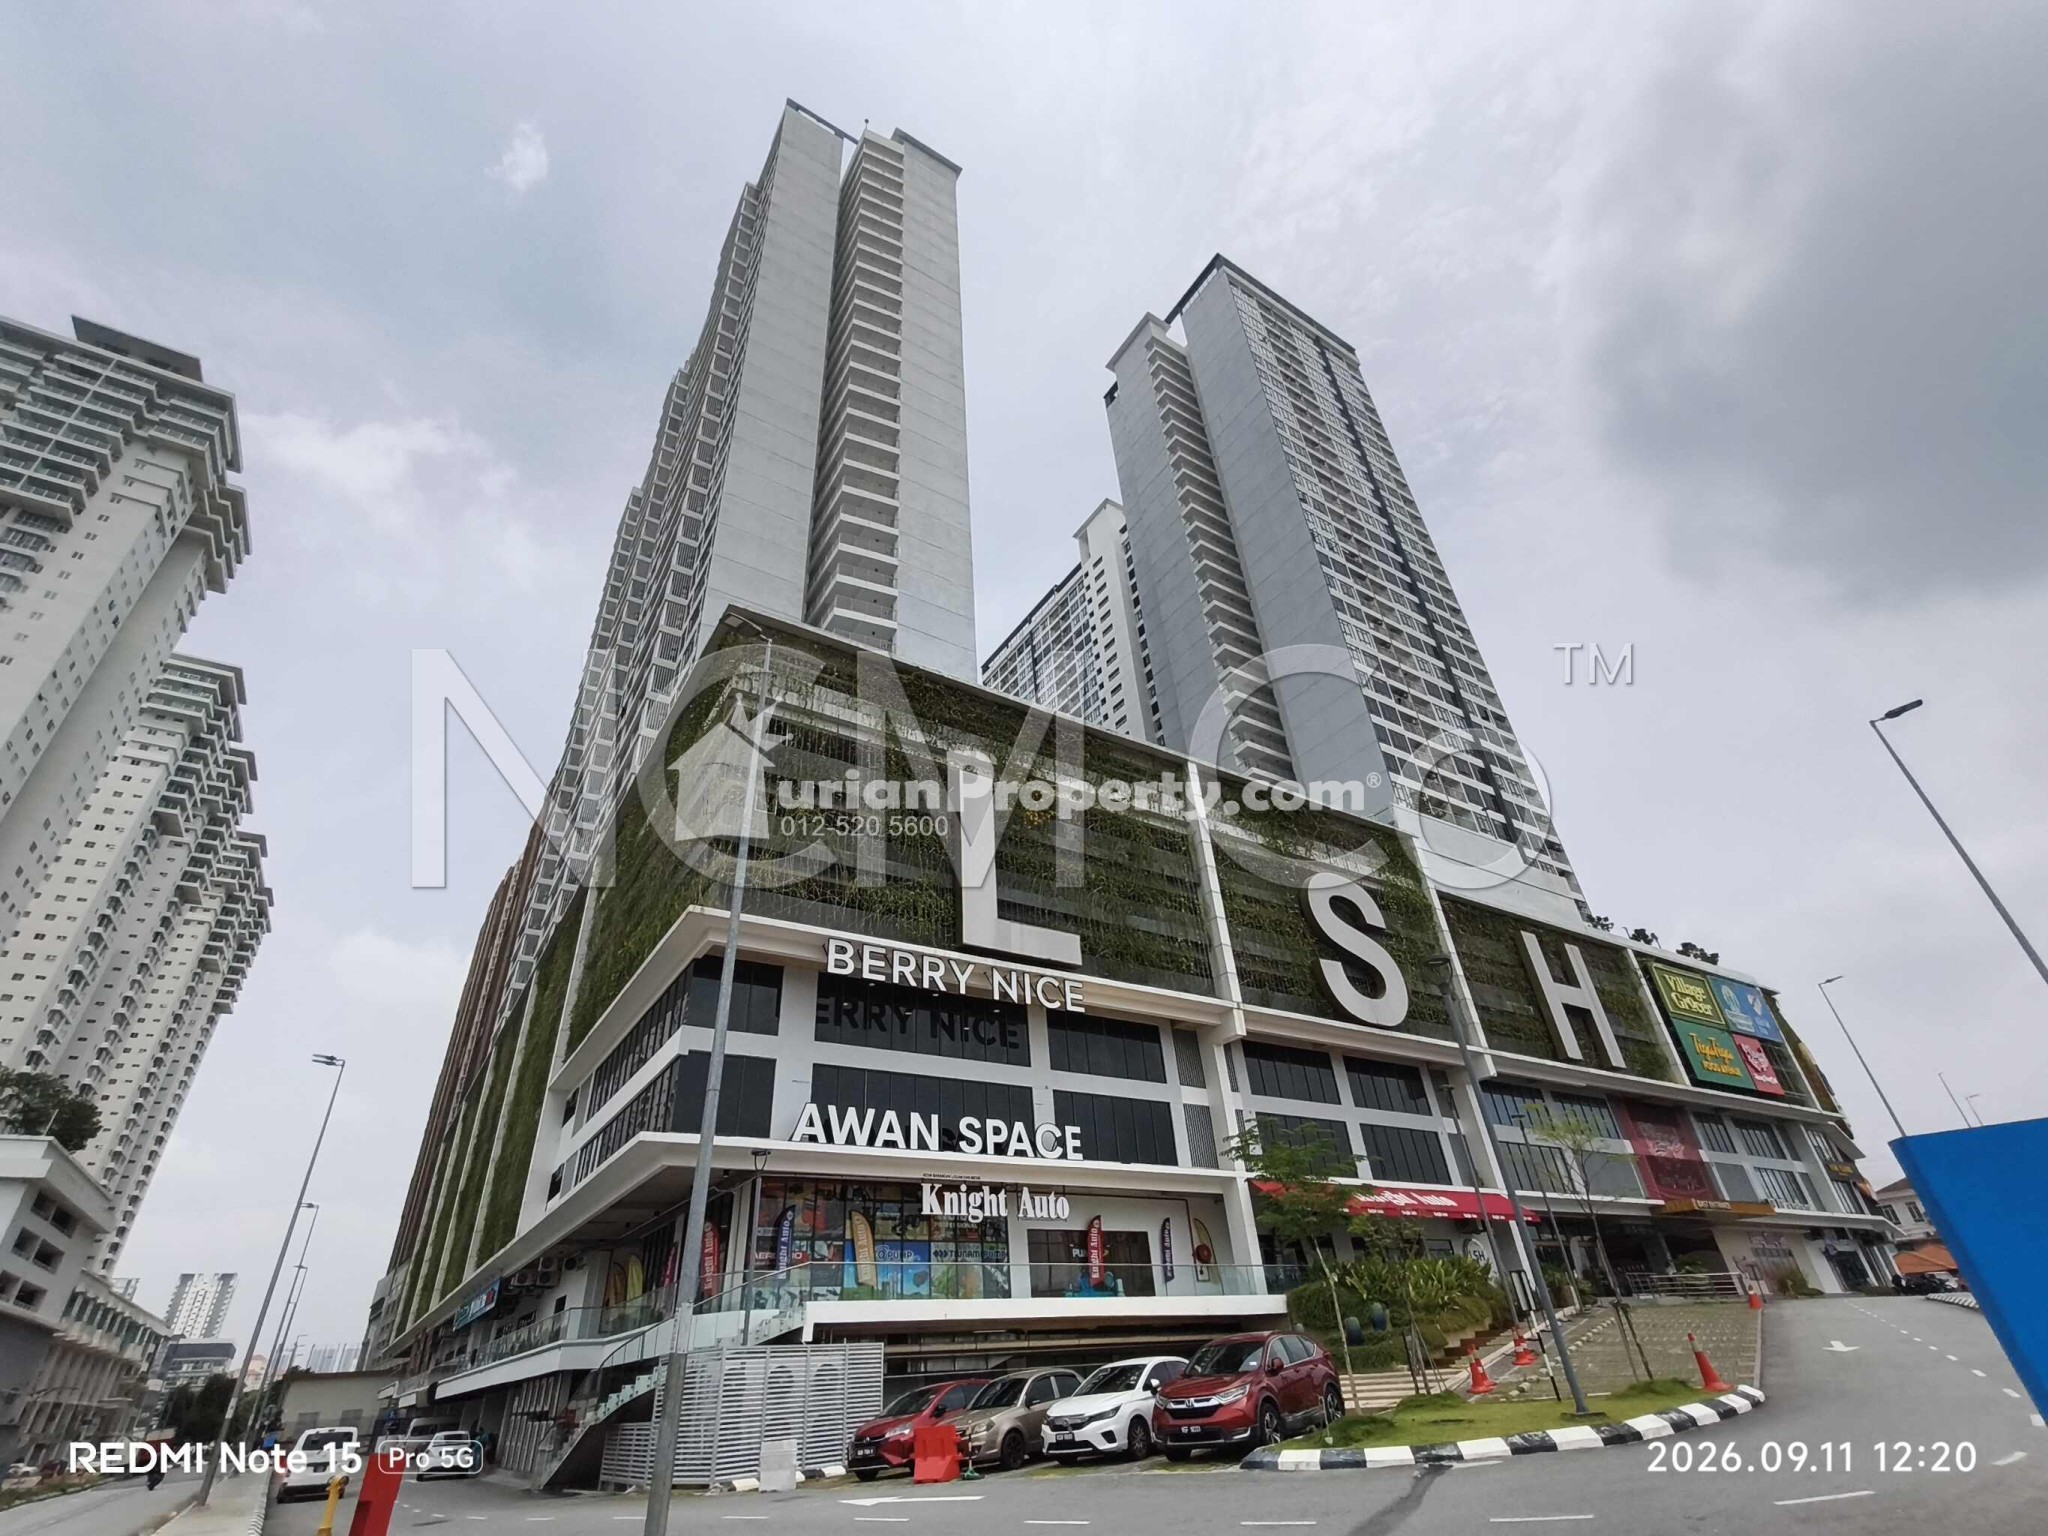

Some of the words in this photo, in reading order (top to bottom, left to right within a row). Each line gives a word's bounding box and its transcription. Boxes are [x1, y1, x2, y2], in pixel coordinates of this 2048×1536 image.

[827, 937, 975, 995] BERRY
[993, 968, 1086, 1013] NICE
[1664, 974, 1707, 1002] Village
[1671, 991, 1714, 1016] Grocer
[792, 1102, 940, 1152] AWAN
[958, 1116, 1084, 1161] SPACE
[921, 1182, 1008, 1224] Knight
[1018, 1186, 1070, 1220] Auto
[781, 1221, 790, 1243] Auto
[1090, 1228, 1099, 1248] Auto
